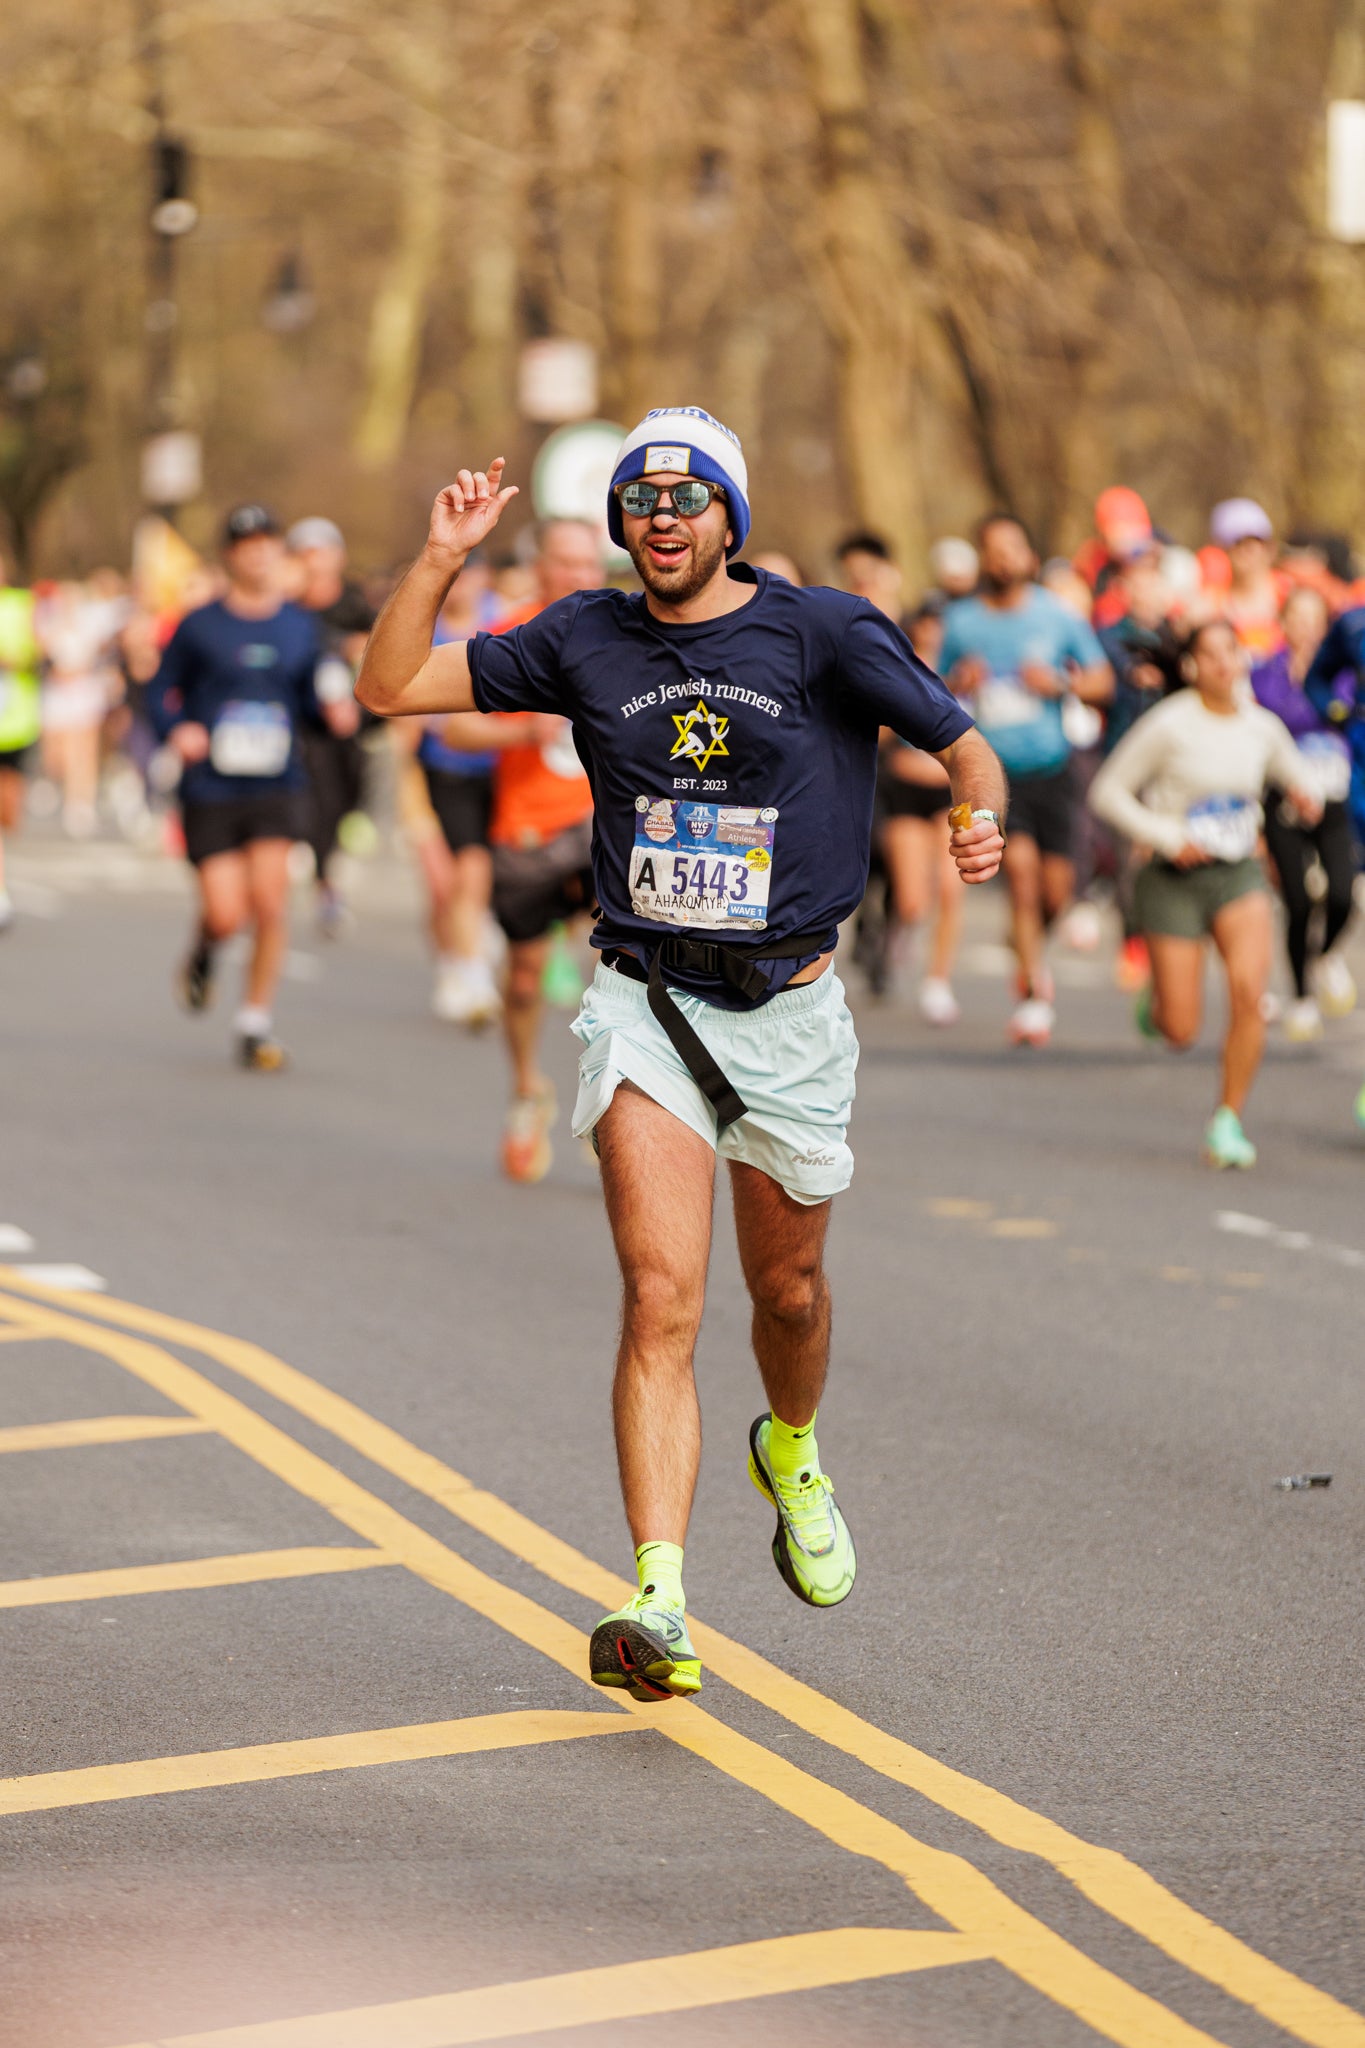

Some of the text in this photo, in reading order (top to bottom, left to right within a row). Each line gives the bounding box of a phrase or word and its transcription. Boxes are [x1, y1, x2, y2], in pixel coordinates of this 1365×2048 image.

[621, 678, 782, 718] nice Jewish runners
[673, 778, 728, 791] EST. 2023
[691, 821, 709, 829] NYC
[727, 833, 757, 844] Athlete
[634, 857, 657, 891] A
[671, 857, 749, 901] 5443
[730, 906, 763, 916] WAVE 1
